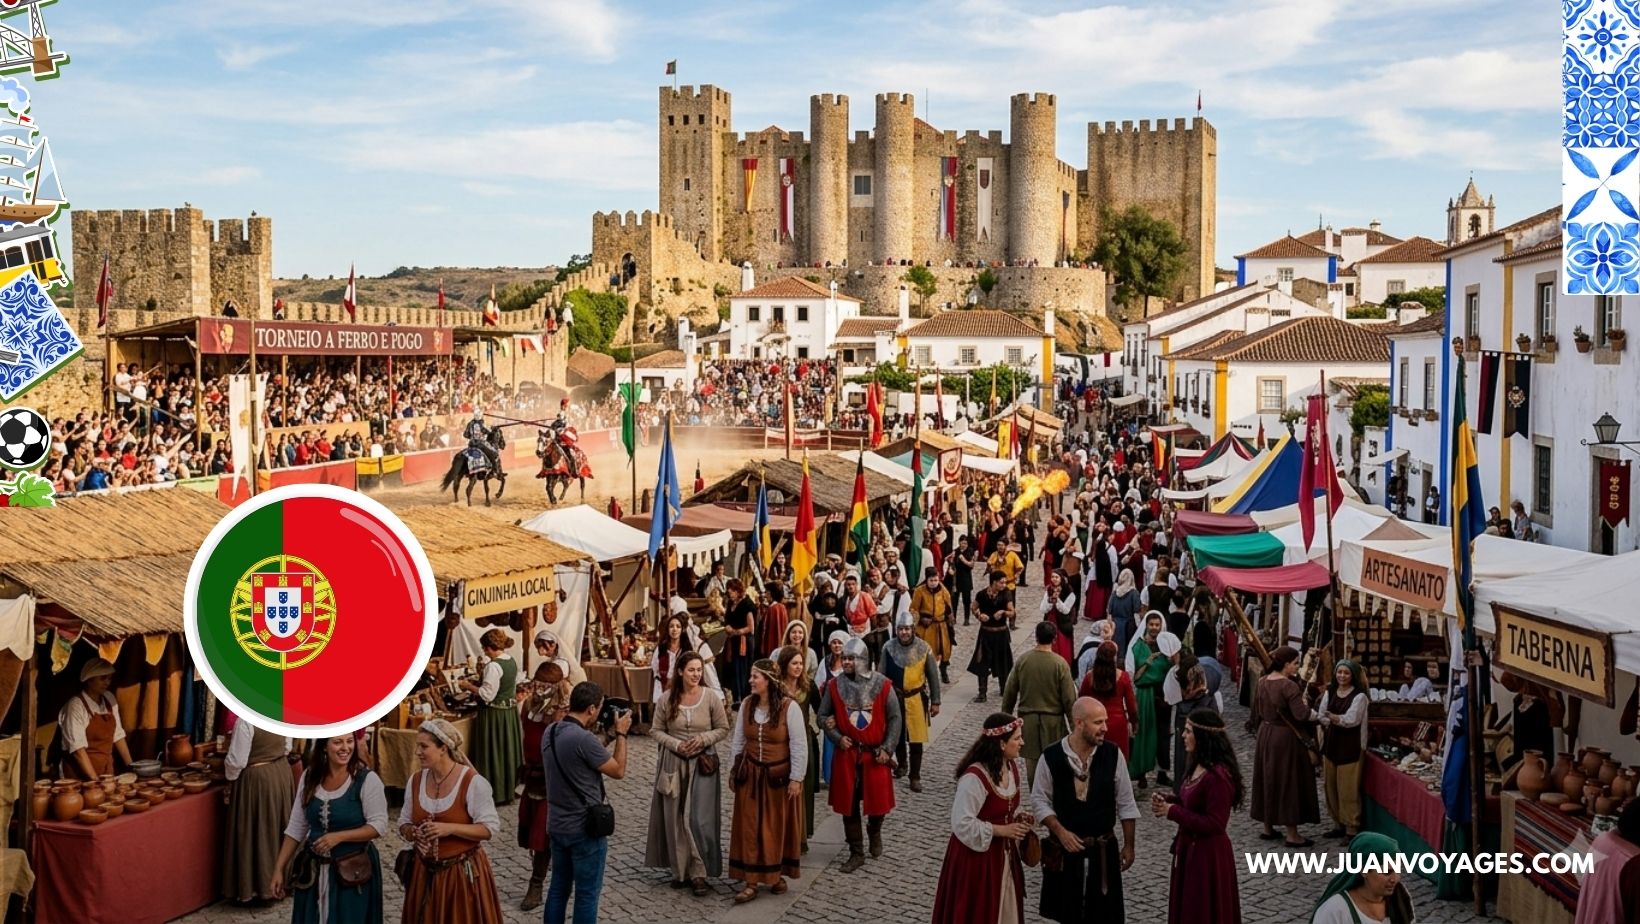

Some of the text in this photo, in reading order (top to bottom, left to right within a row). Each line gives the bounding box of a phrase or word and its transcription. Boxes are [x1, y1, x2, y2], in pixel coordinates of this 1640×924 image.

[255, 328, 321, 348] TORNEIO
[325, 330, 335, 349] A
[381, 332, 388, 349] E
[391, 332, 423, 350] POGO
[520, 576, 551, 597] LOCAL
[1364, 557, 1444, 601] ARTESANATO
[1507, 624, 1595, 681] TABERNA
